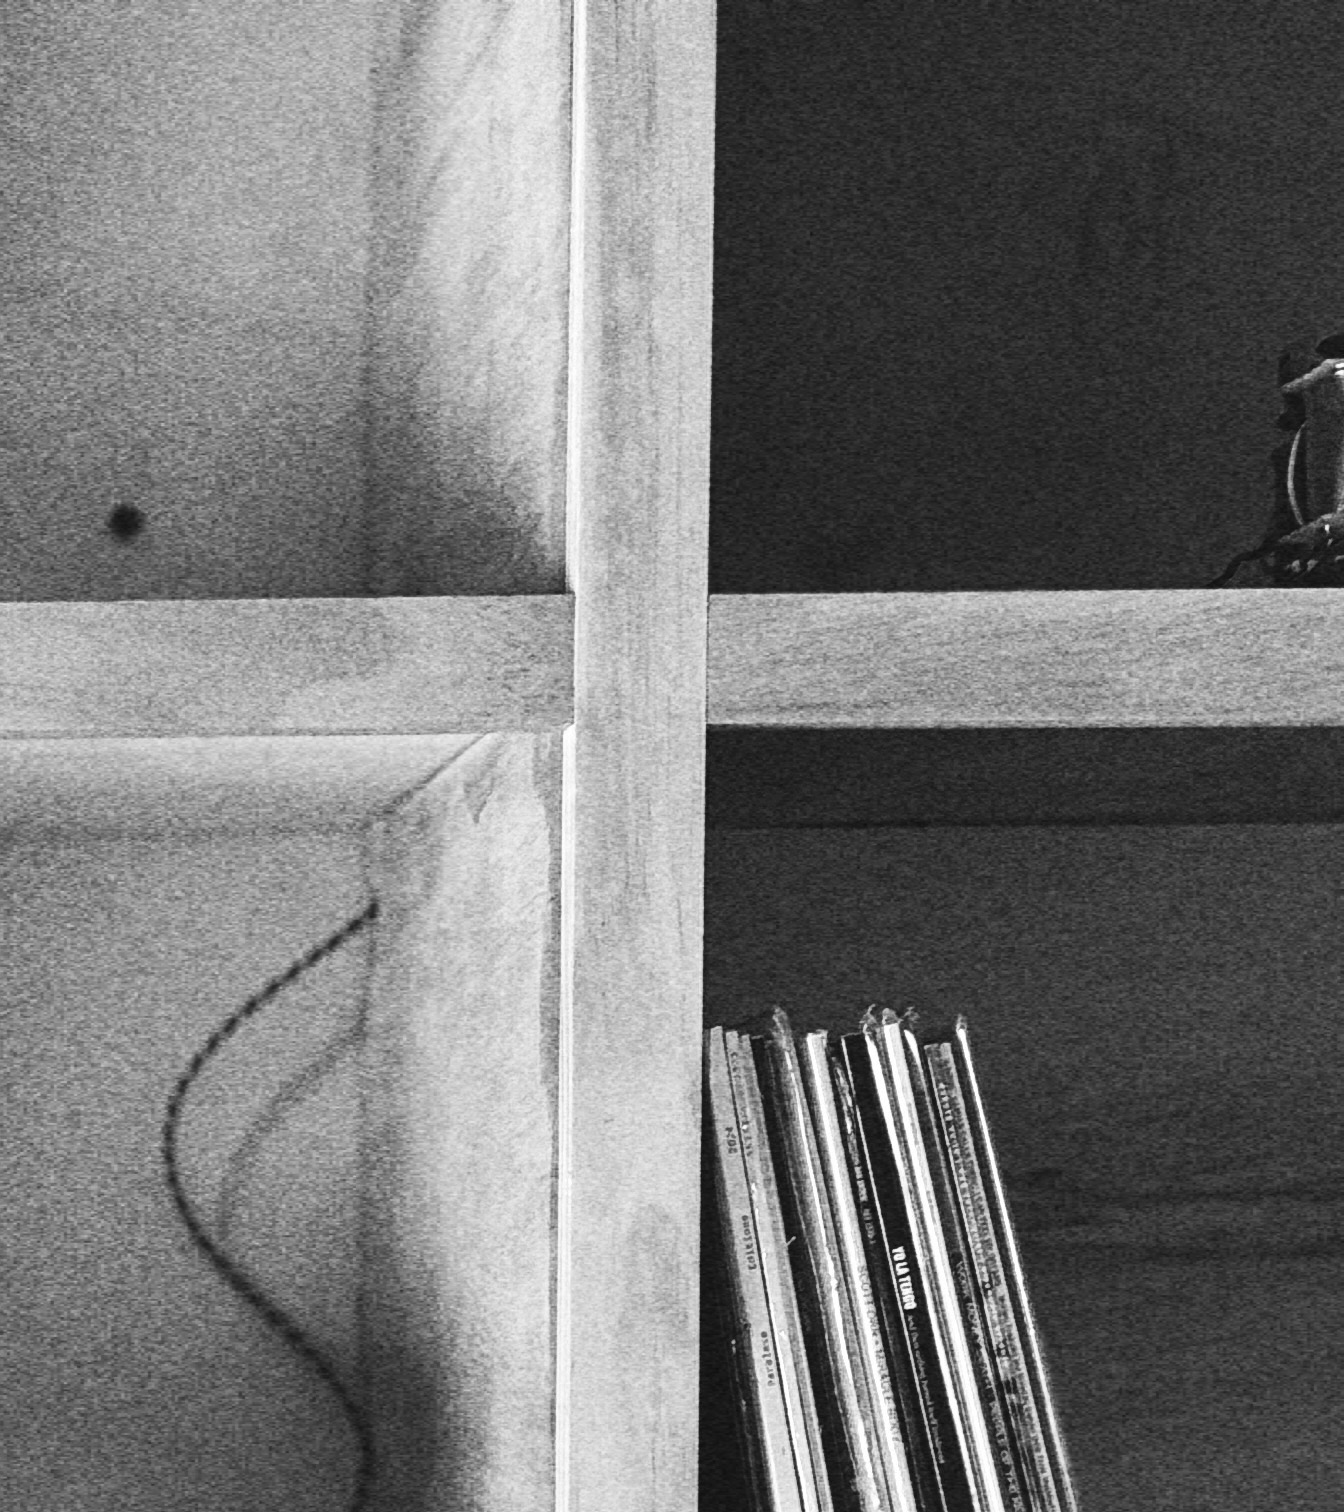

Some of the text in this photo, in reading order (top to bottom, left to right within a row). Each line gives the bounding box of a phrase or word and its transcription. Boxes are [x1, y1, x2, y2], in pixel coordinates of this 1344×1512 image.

[892, 1245, 917, 1311] YO LA TENGO
